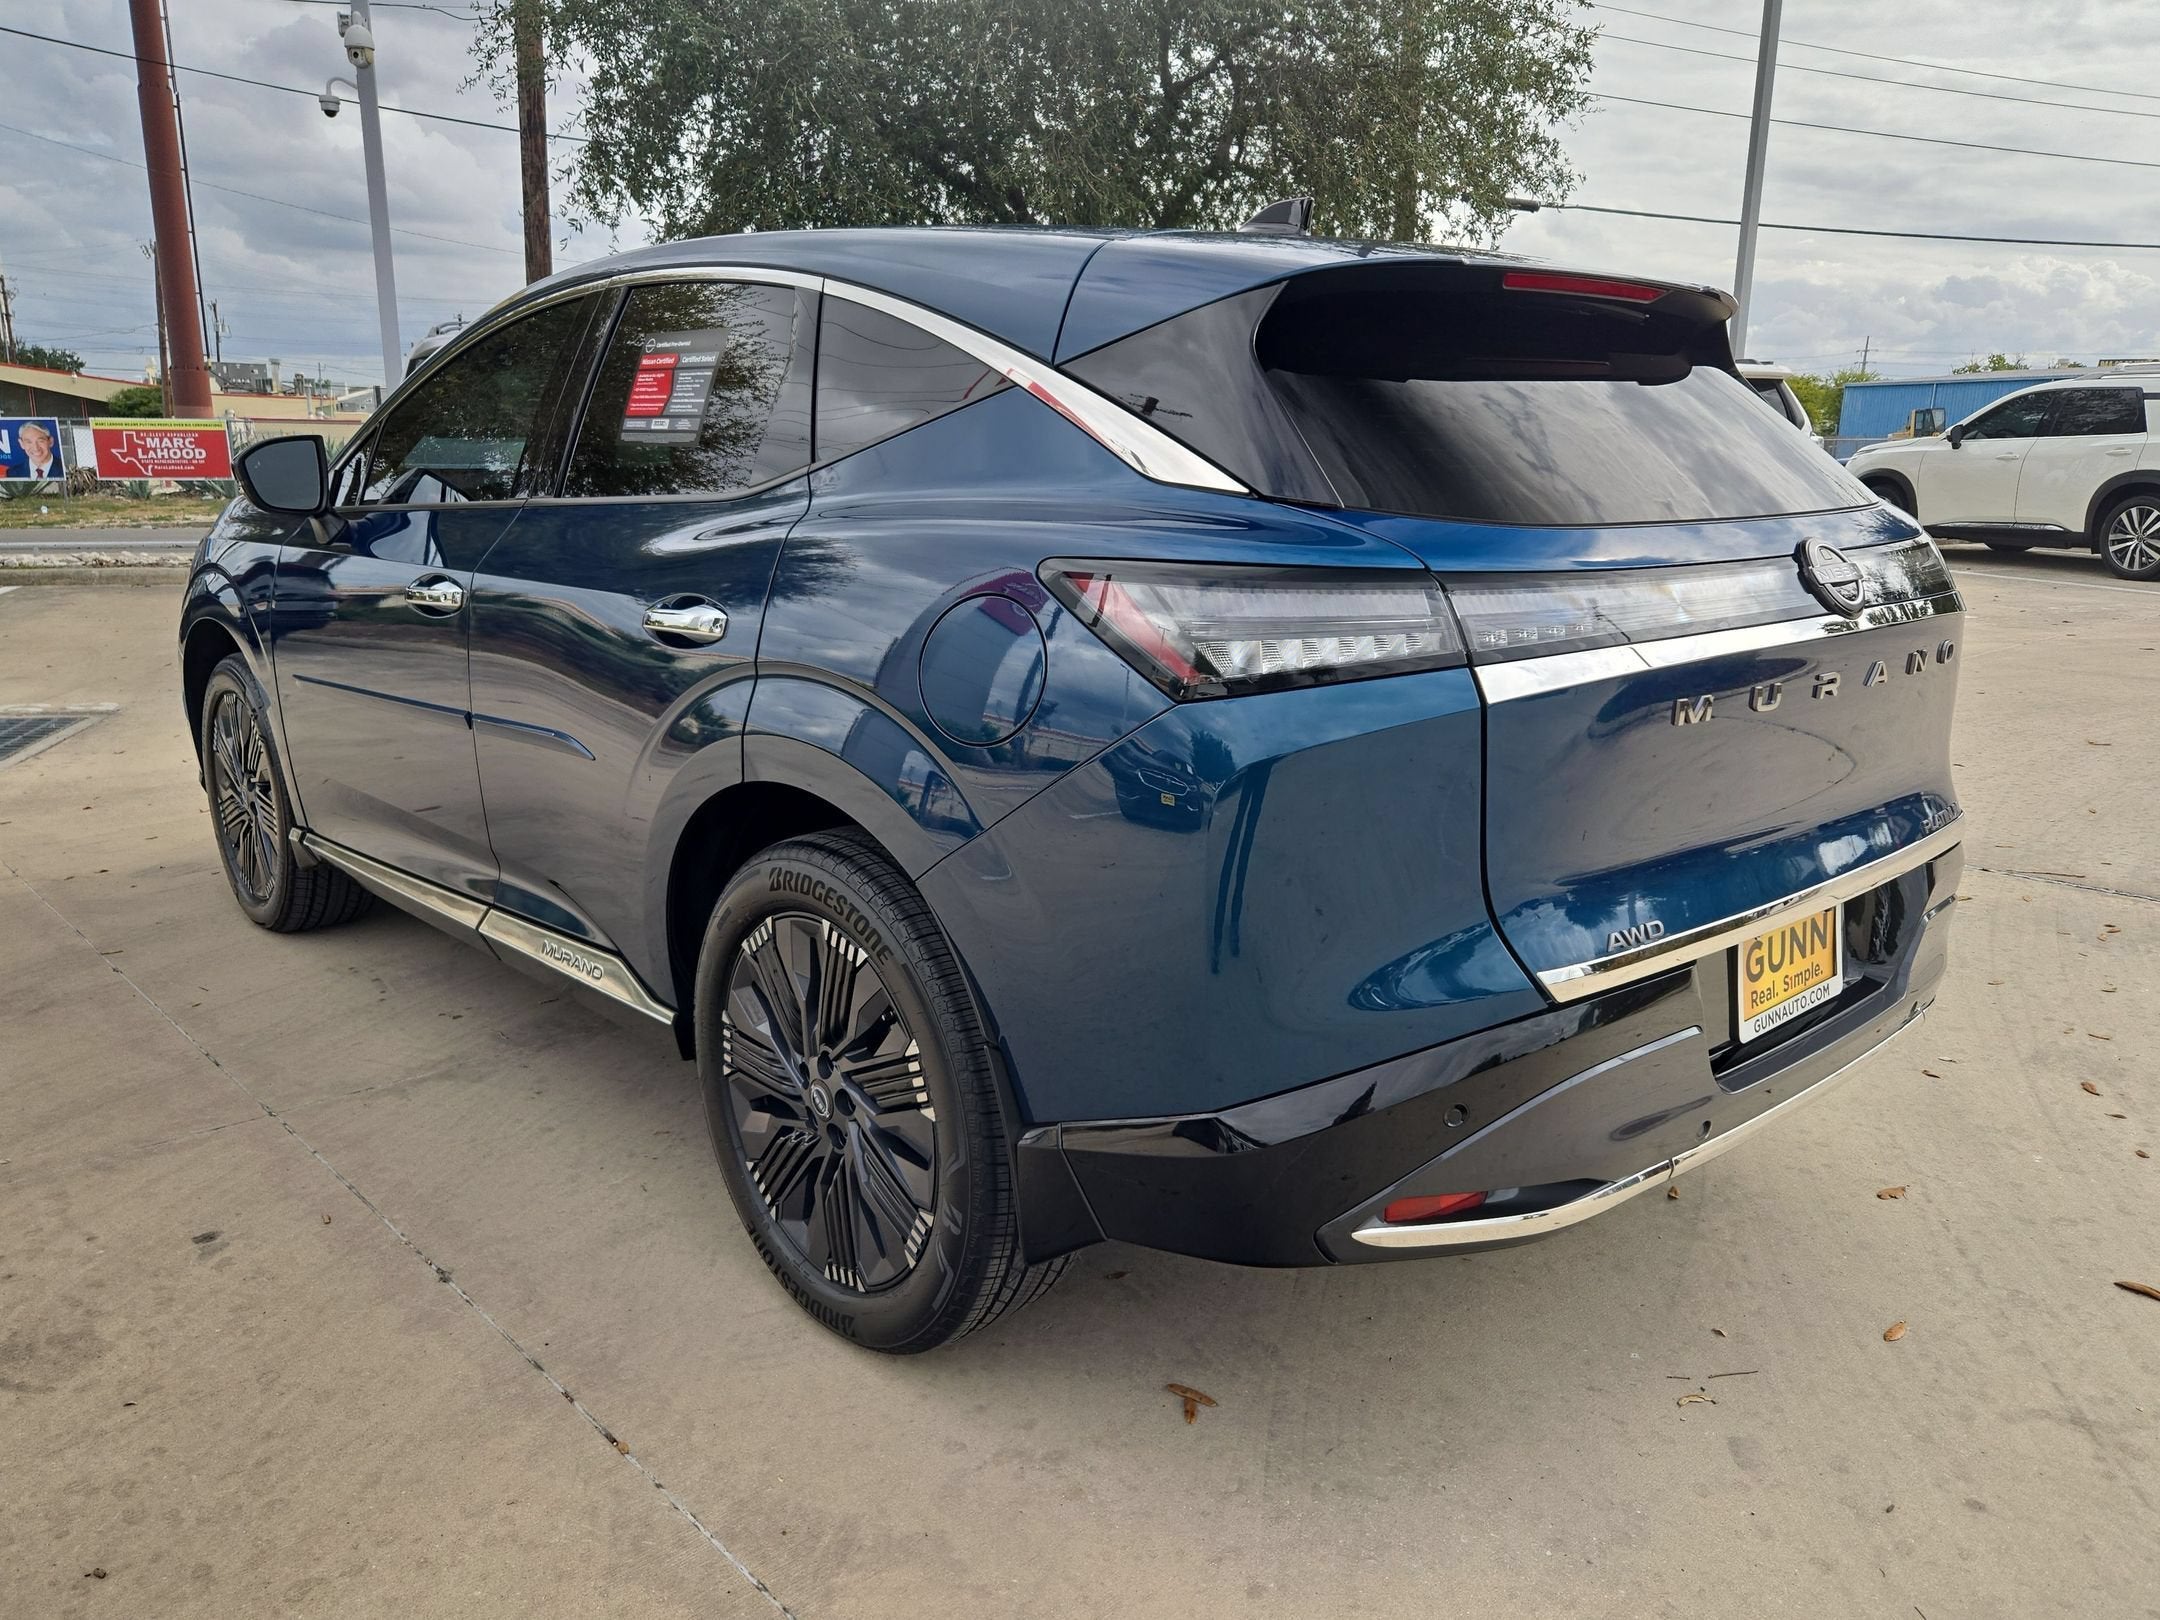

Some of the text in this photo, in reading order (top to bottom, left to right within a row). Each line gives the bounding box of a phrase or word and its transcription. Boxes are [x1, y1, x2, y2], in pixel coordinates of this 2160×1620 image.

[145, 437, 196, 449] MARC
[1671, 639, 1955, 727] MURANO
[769, 867, 894, 966] BRIDGESTONE
[1607, 920, 1665, 952] AWD
[541, 939, 605, 980] MURANO
[1746, 912, 1828, 983] GUNN
[1750, 981, 1779, 1009] Real.
[1754, 983, 1830, 1033] GUNNAUTO.COM
